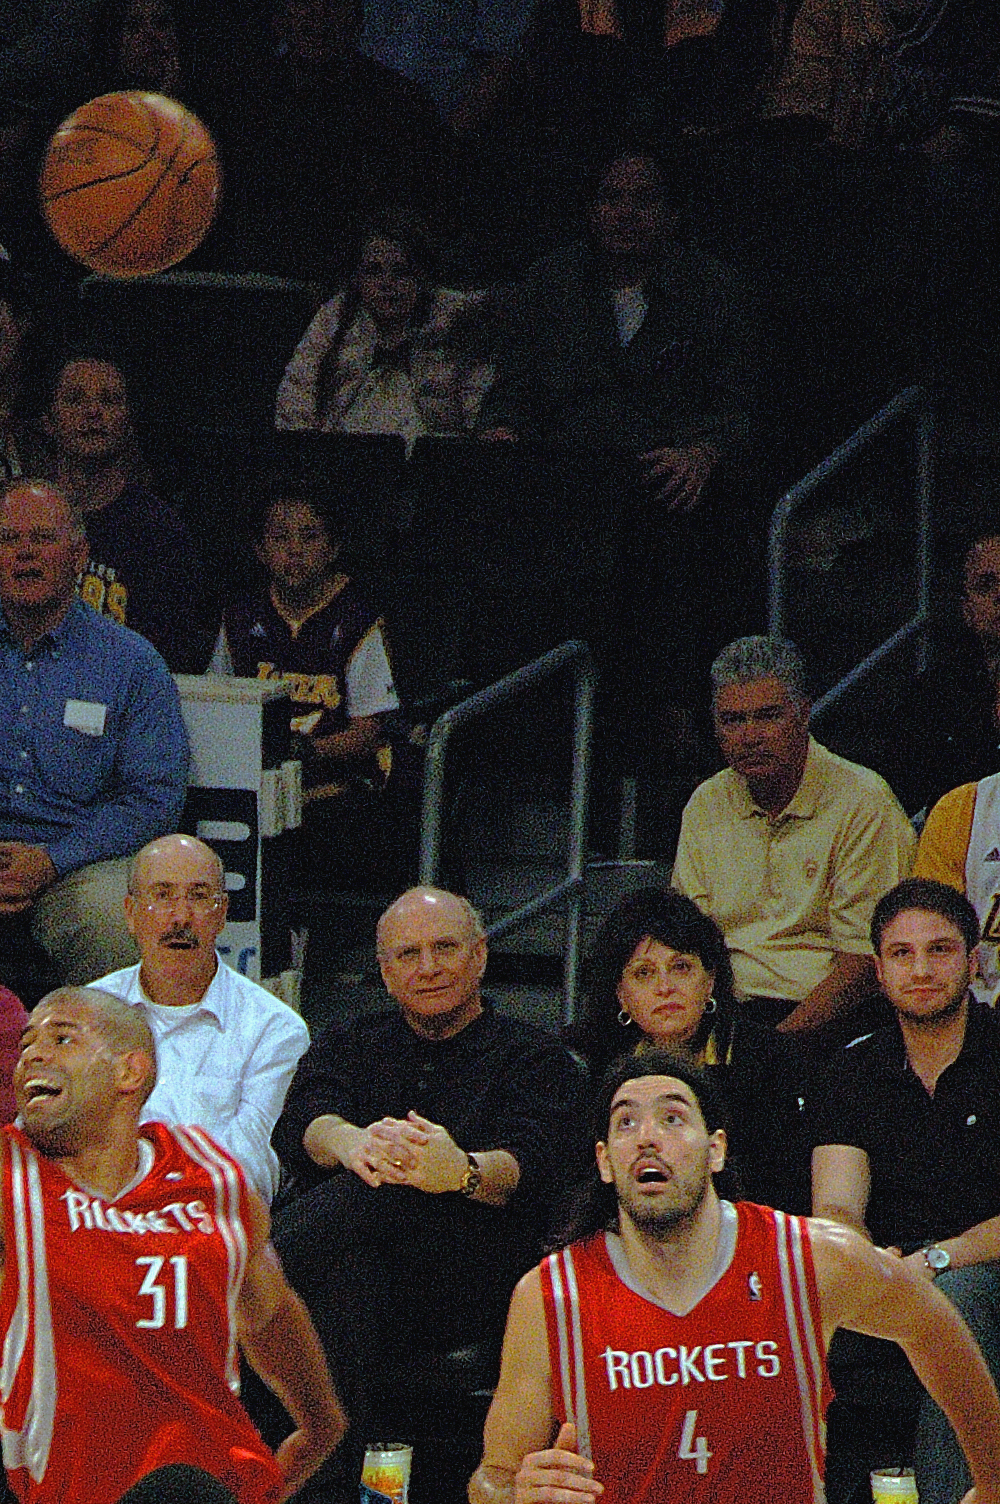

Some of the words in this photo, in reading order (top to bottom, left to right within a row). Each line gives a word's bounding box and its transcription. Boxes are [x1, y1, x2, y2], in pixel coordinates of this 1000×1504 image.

[135, 1255, 189, 1329] 31
[600, 1340, 781, 1391] ROCKETS
[678, 1410, 713, 1474] 4
